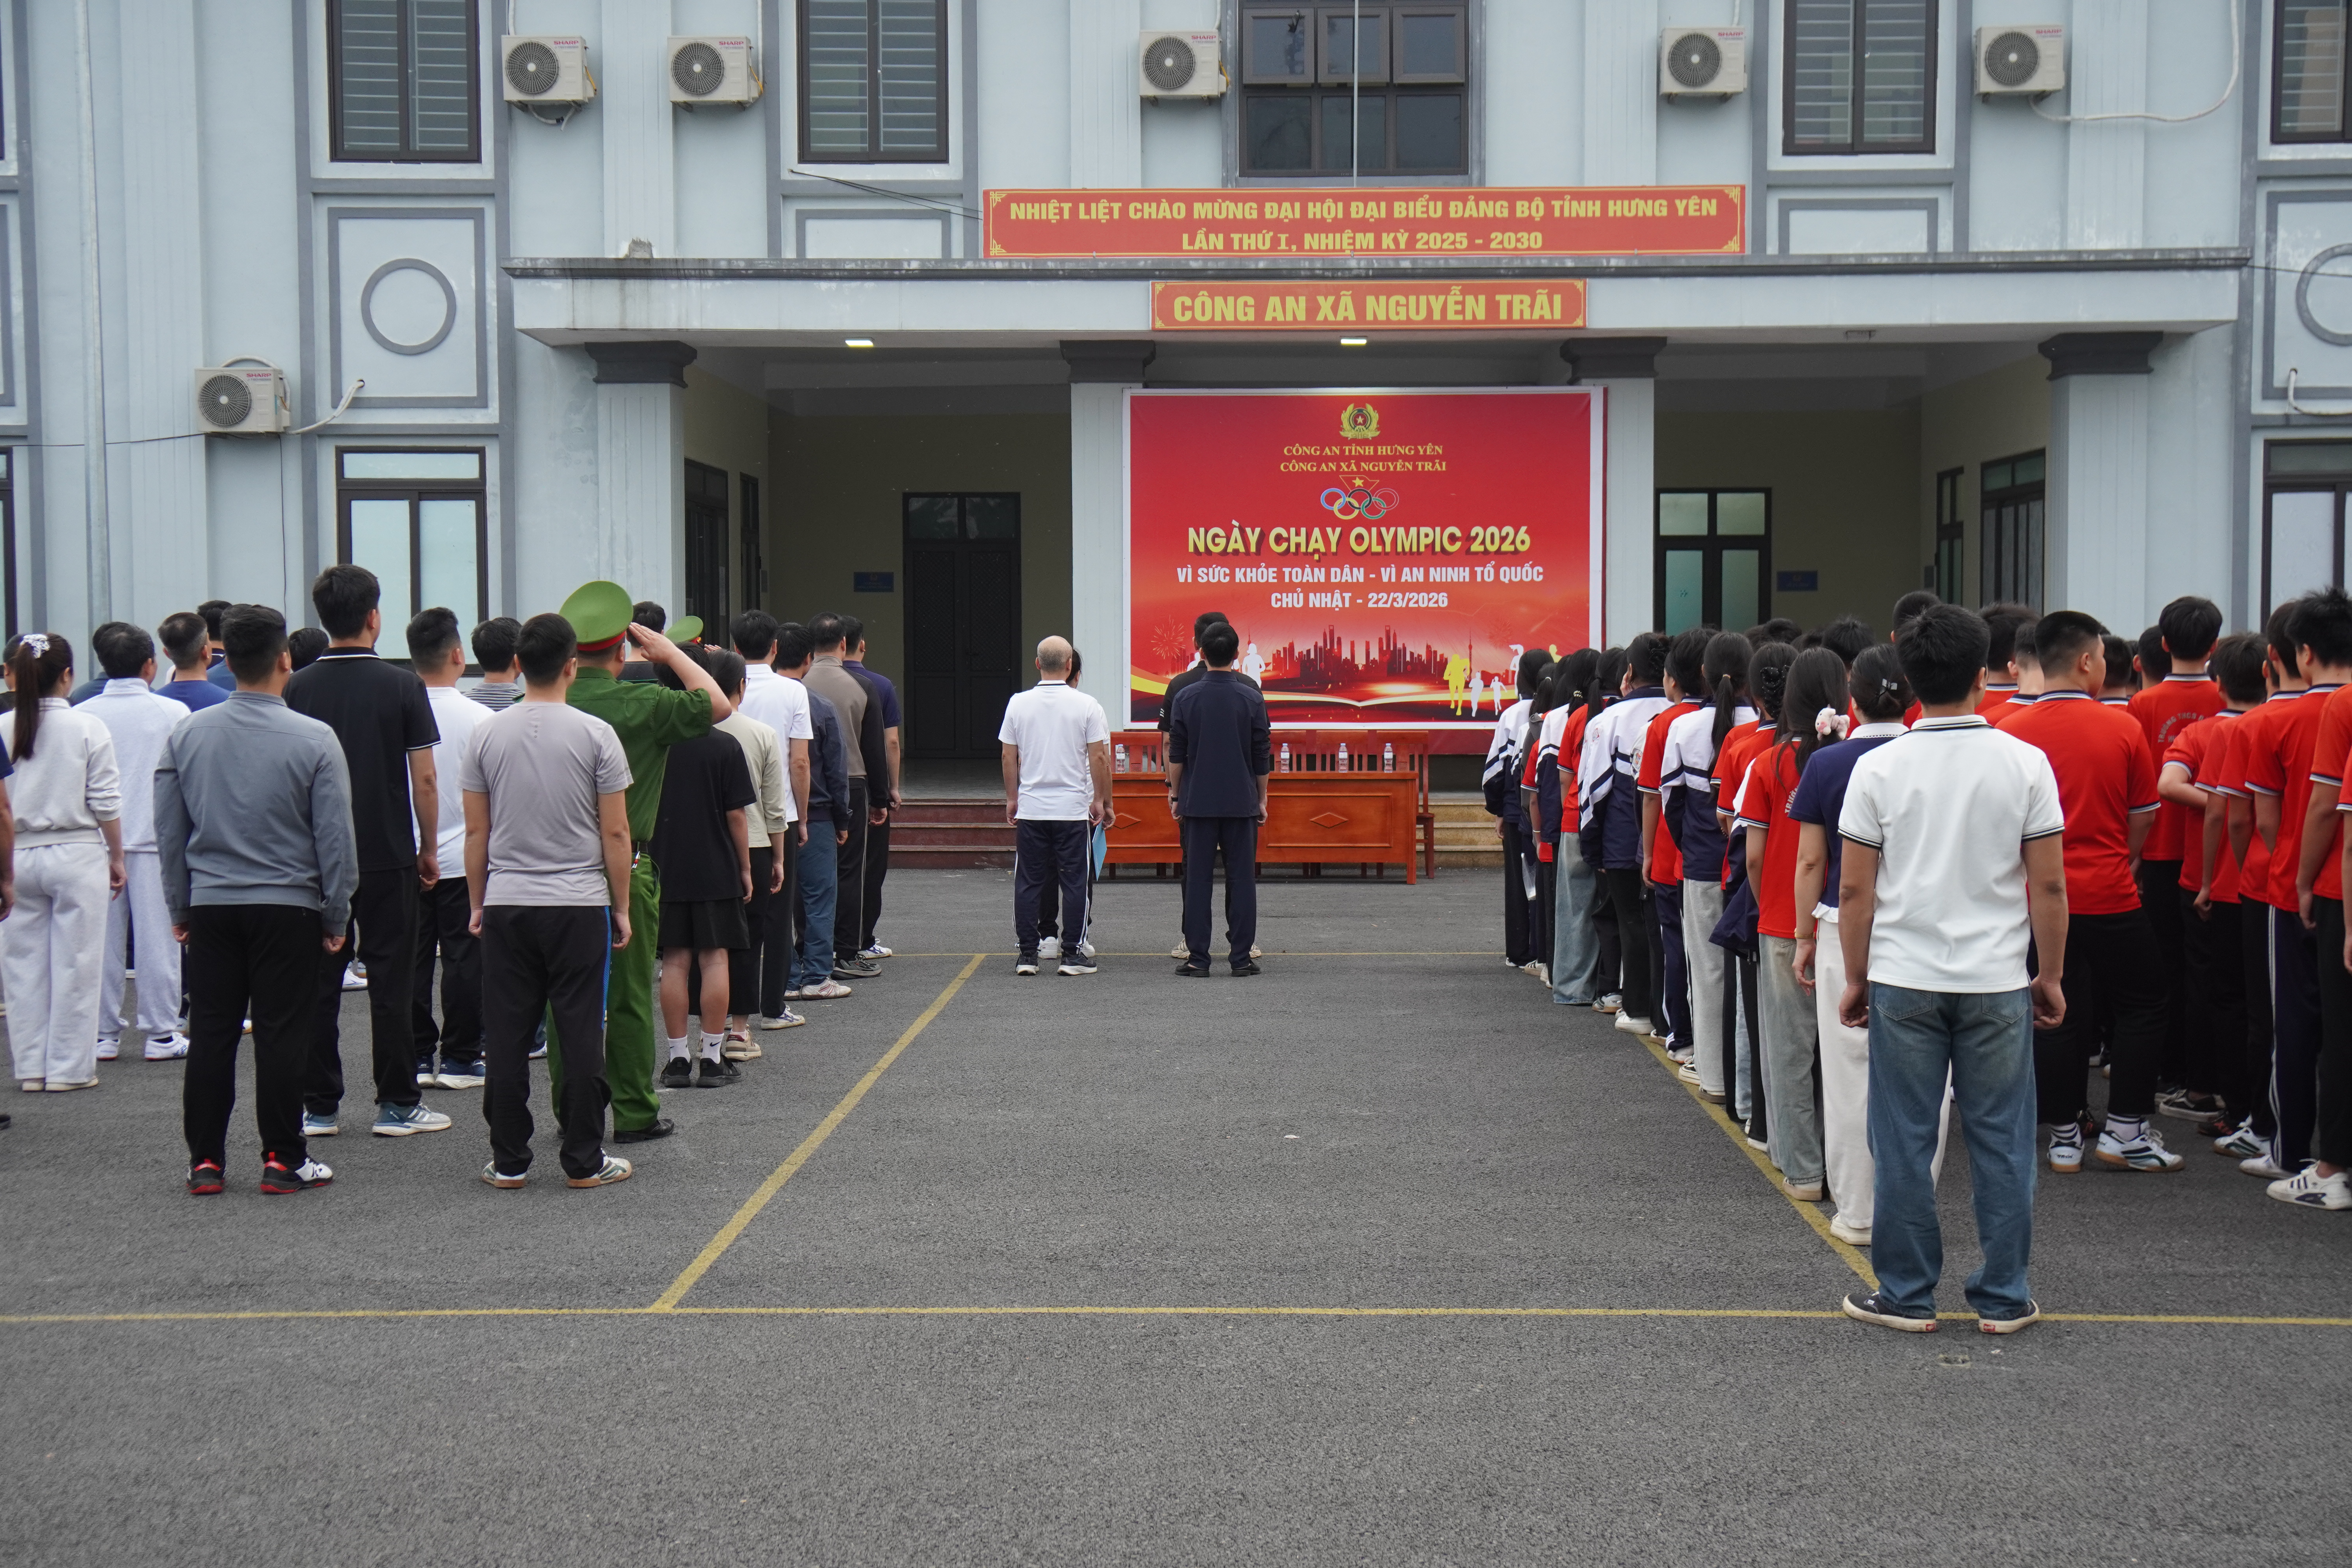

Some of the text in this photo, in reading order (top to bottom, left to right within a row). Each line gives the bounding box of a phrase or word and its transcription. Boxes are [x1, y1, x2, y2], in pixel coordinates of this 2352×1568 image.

[1011, 194, 1717, 223] NHIỆT LIỆT CHÀO MỪNG ĐẠI HỘI ĐẠI BIỂU ĐẢNG BỘ TỈNH HƯNG YÊN
[1182, 227, 1223, 250] LẦN
[1230, 230, 1273, 250] THỨ
[1277, 234, 1296, 252] I,
[1304, 229, 1374, 252] NHIỆM
[1382, 229, 1409, 249] KỲ
[1416, 232, 1468, 249] 2025
[1490, 232, 1542, 249] 2030
[1174, 286, 1561, 322] CÔNG AN XÃ NGUYỄN TRÃI
[1284, 443, 1443, 455] CÔNG AN TỈNH HƯNG YÊN
[1280, 459, 1446, 472] CÔNG AN XÃ NGUYỄN TRÃI
[1189, 519, 1530, 560] NGÀY CHẠY OLYMPIC 2026
[1177, 564, 1192, 583] VÌ
[1197, 564, 1230, 583] SỨC
[1235, 563, 1278, 583] KHỎE
[1283, 564, 1325, 583] TOÀN
[1331, 564, 1364, 583] DÂN
[1381, 564, 1396, 582] VÌ
[1401, 567, 1424, 582] AN
[1429, 567, 1469, 582] NINH
[1474, 561, 1495, 582] TỔ
[1499, 561, 1543, 583] QUỐC
[1271, 588, 1303, 608] CHỦ
[1309, 590, 1352, 611] NHẬT
[1368, 592, 1448, 608] 22/3/2026
